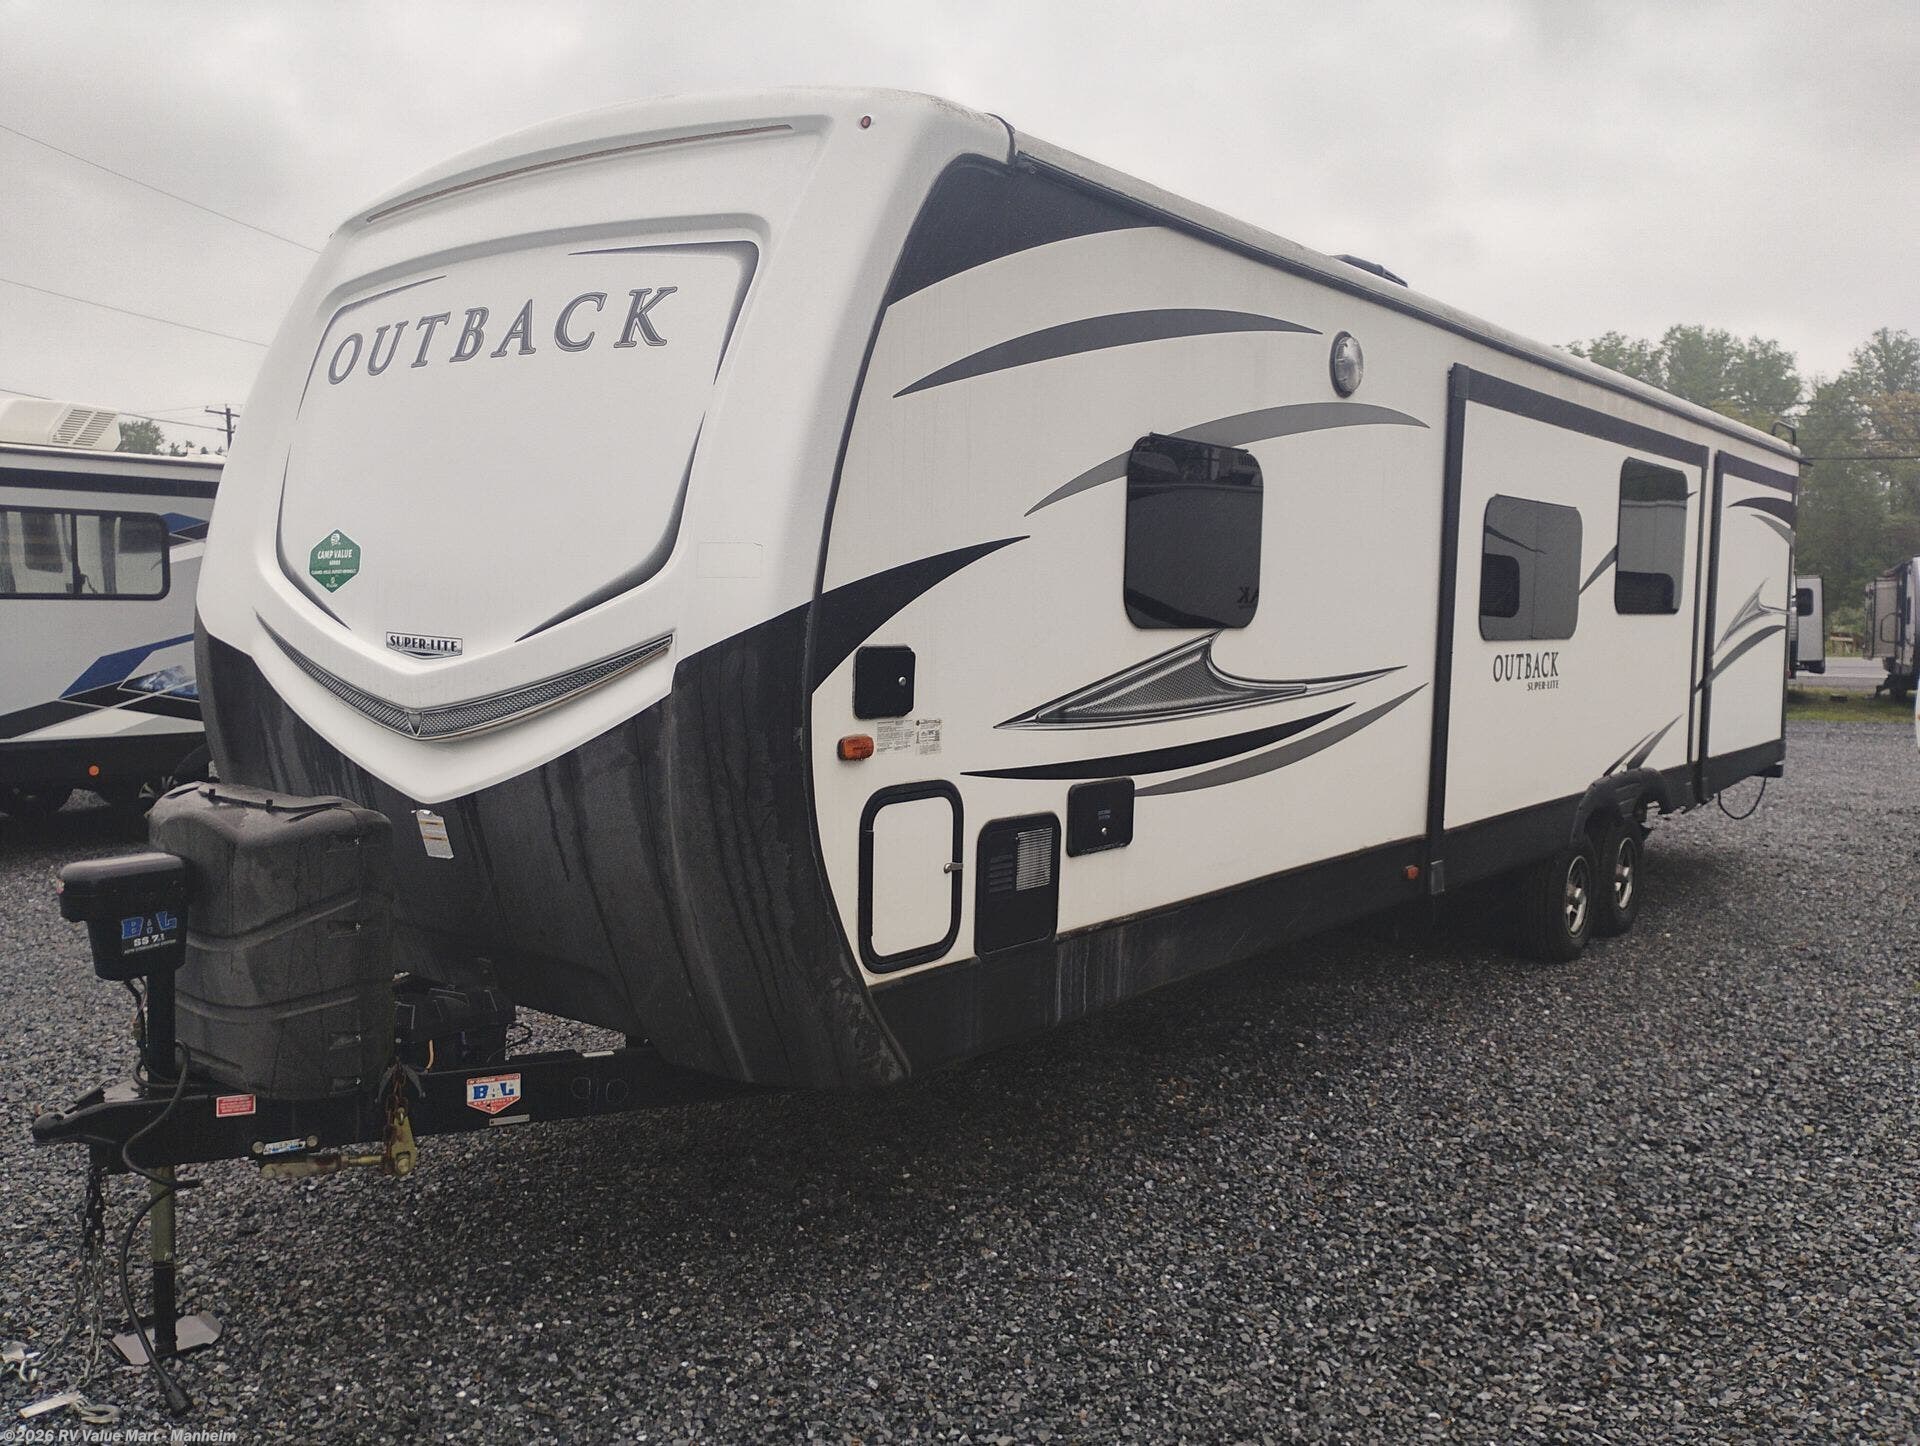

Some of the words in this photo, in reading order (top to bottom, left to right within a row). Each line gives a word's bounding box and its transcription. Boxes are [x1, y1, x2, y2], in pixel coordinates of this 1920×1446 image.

[327, 286, 678, 386] OUTBACK
[317, 550, 334, 560] CAMP
[334, 549, 352, 558] VALUE
[1493, 652, 1559, 682] OUTBACK
